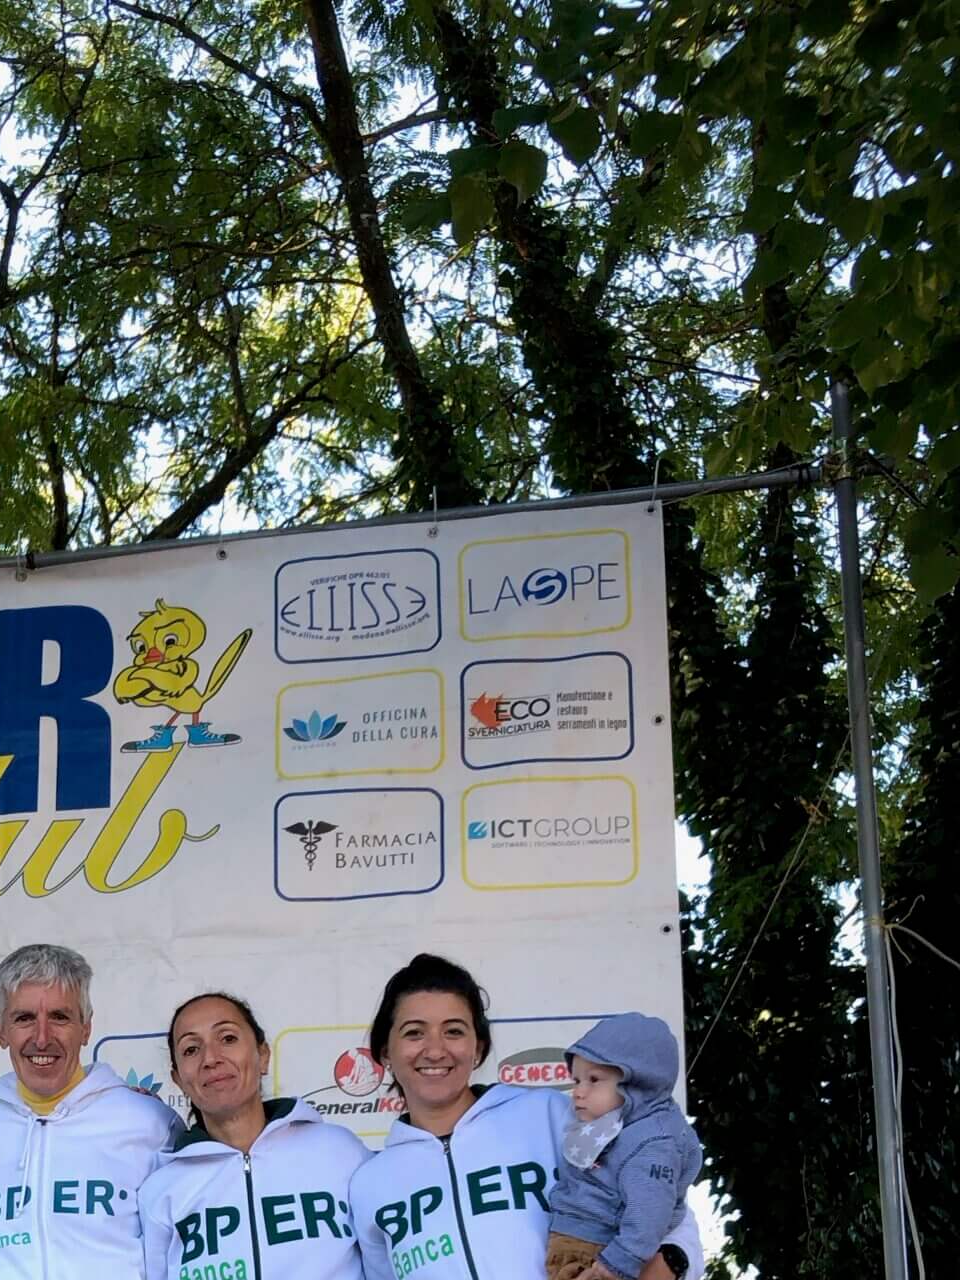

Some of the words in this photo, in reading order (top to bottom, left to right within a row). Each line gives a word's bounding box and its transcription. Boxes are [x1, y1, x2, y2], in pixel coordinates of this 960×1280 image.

[362, 707, 428, 725] OFFICINA
[494, 698, 551, 722] ECO
[352, 728, 393, 743] DELLA
[400, 725, 439, 740] CURA
[468, 720, 551, 737] SVERNICIATURA
[501, 1064, 568, 1083] GENER
[306, 1097, 405, 1116] eneralKo
